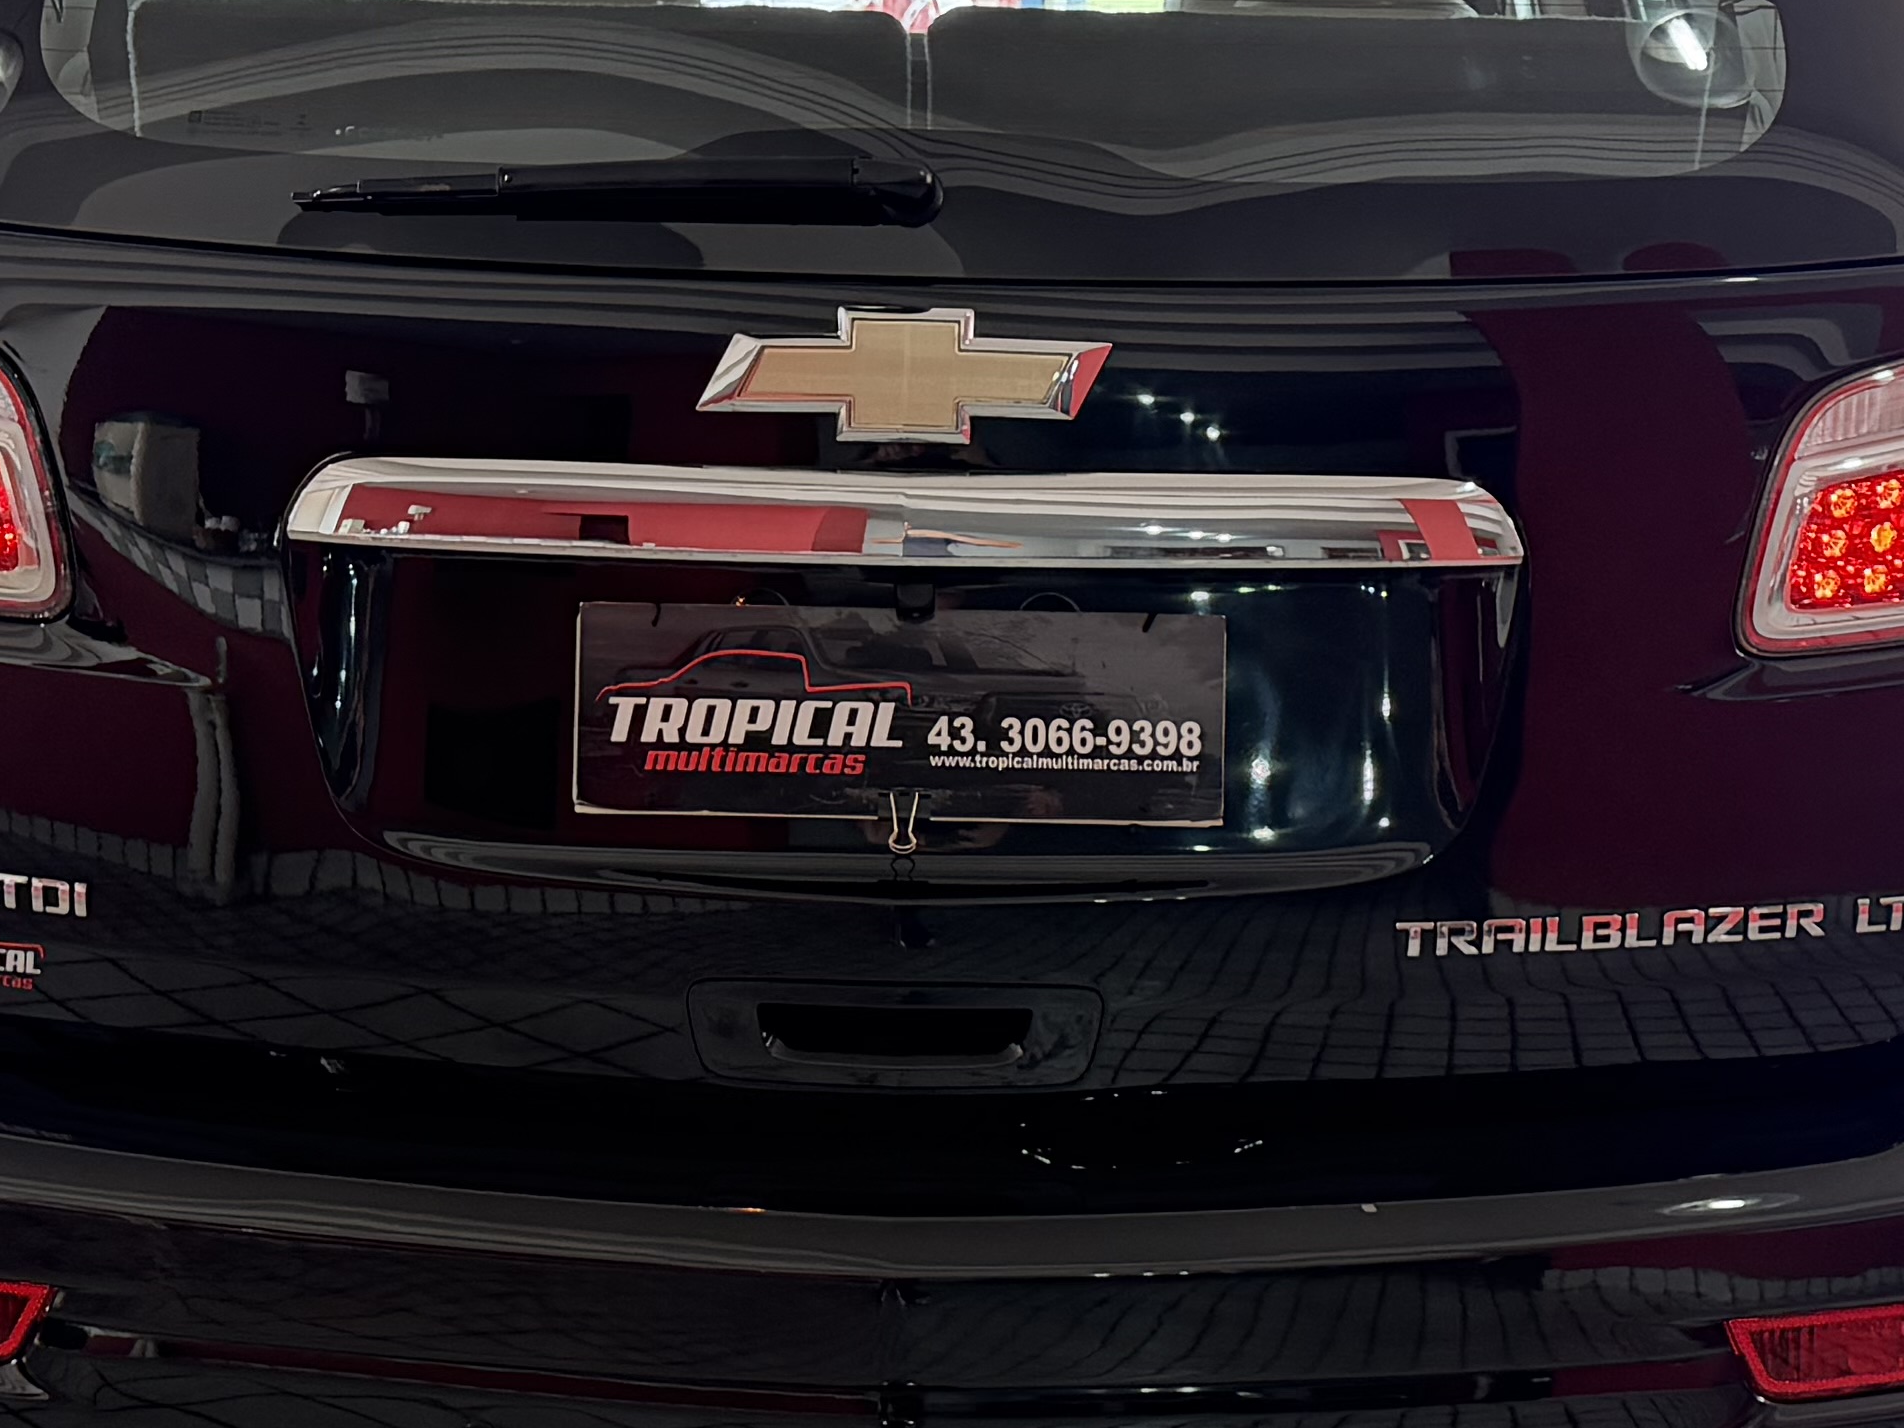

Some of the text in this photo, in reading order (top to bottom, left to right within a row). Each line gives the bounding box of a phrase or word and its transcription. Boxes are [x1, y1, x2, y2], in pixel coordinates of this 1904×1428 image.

[607, 696, 904, 748] TROPICAL
[927, 715, 1203, 758] 43. 3066-9398
[643, 746, 867, 776] multimarcas
[929, 753, 1201, 773] www.tropicalmultimarcas.com.br
[1395, 901, 1826, 958] TRAILBLAZER
